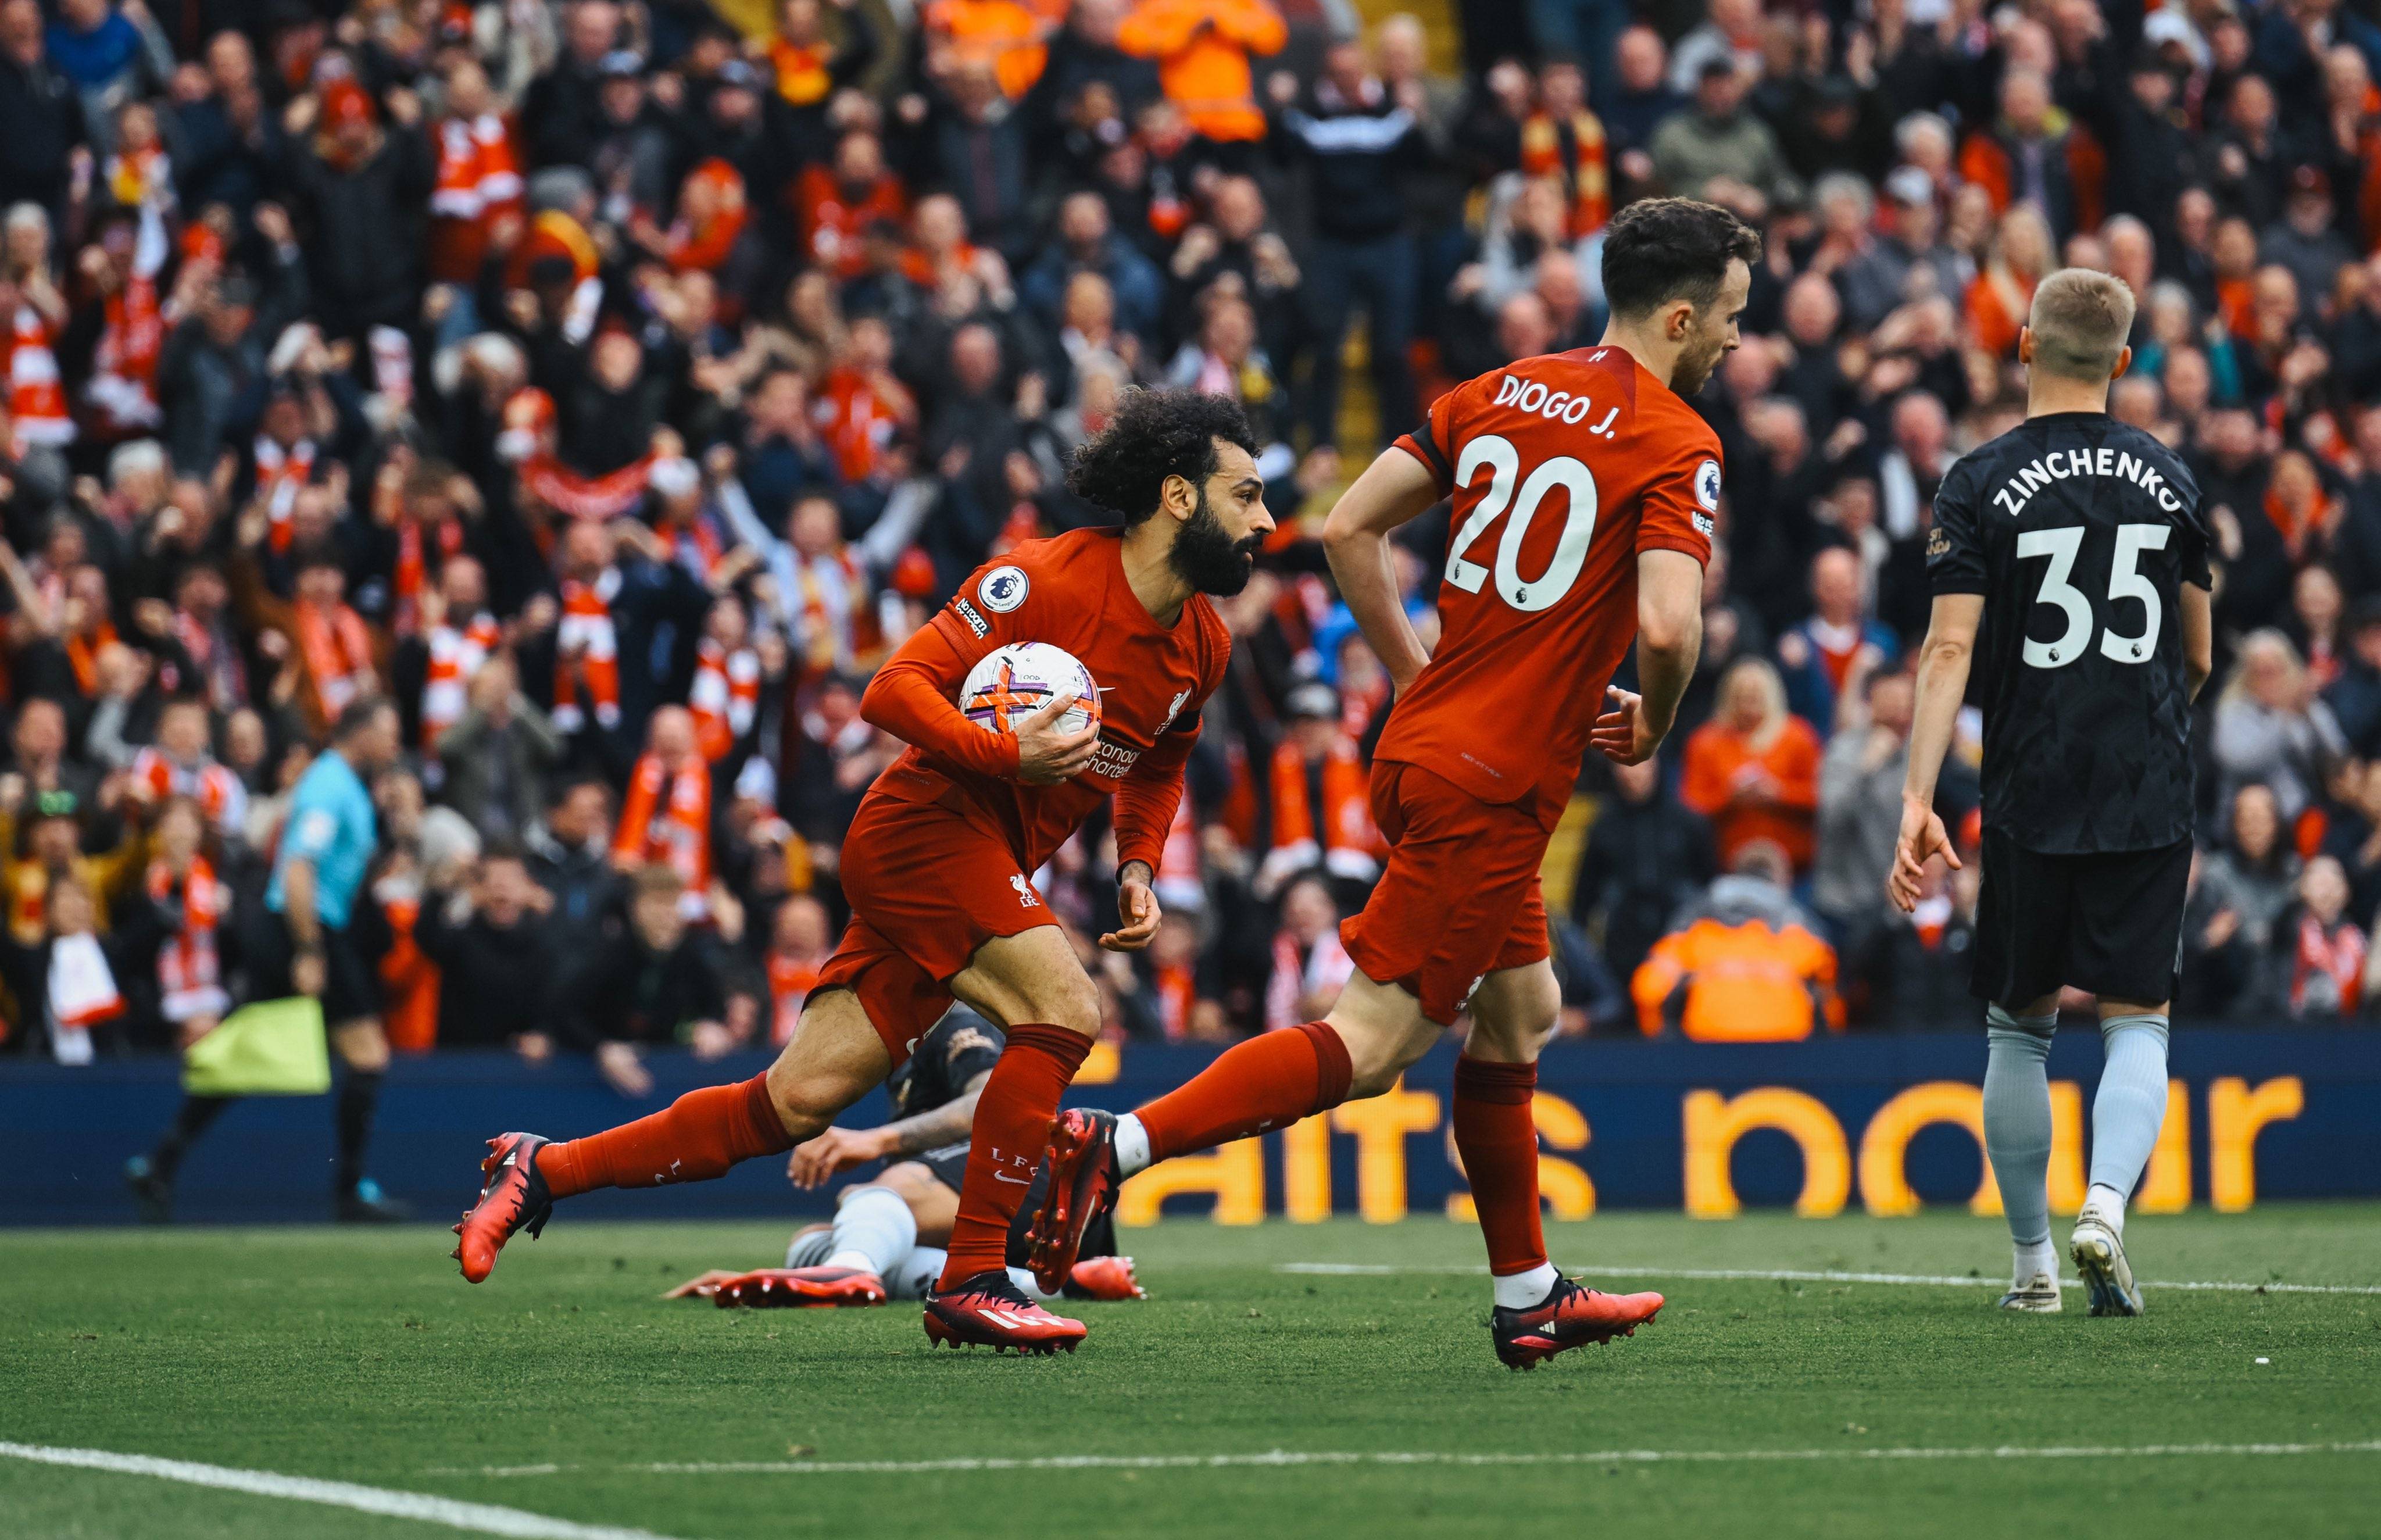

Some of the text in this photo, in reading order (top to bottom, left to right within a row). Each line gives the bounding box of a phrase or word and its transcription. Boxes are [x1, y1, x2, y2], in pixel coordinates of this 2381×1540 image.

[1493, 375, 1620, 440] DIOGO J.
[1993, 448, 2182, 516] ZINCHENKO
[1444, 434, 1598, 612] 20
[959, 597, 988, 632] No room
[2017, 523, 2171, 669] 35
